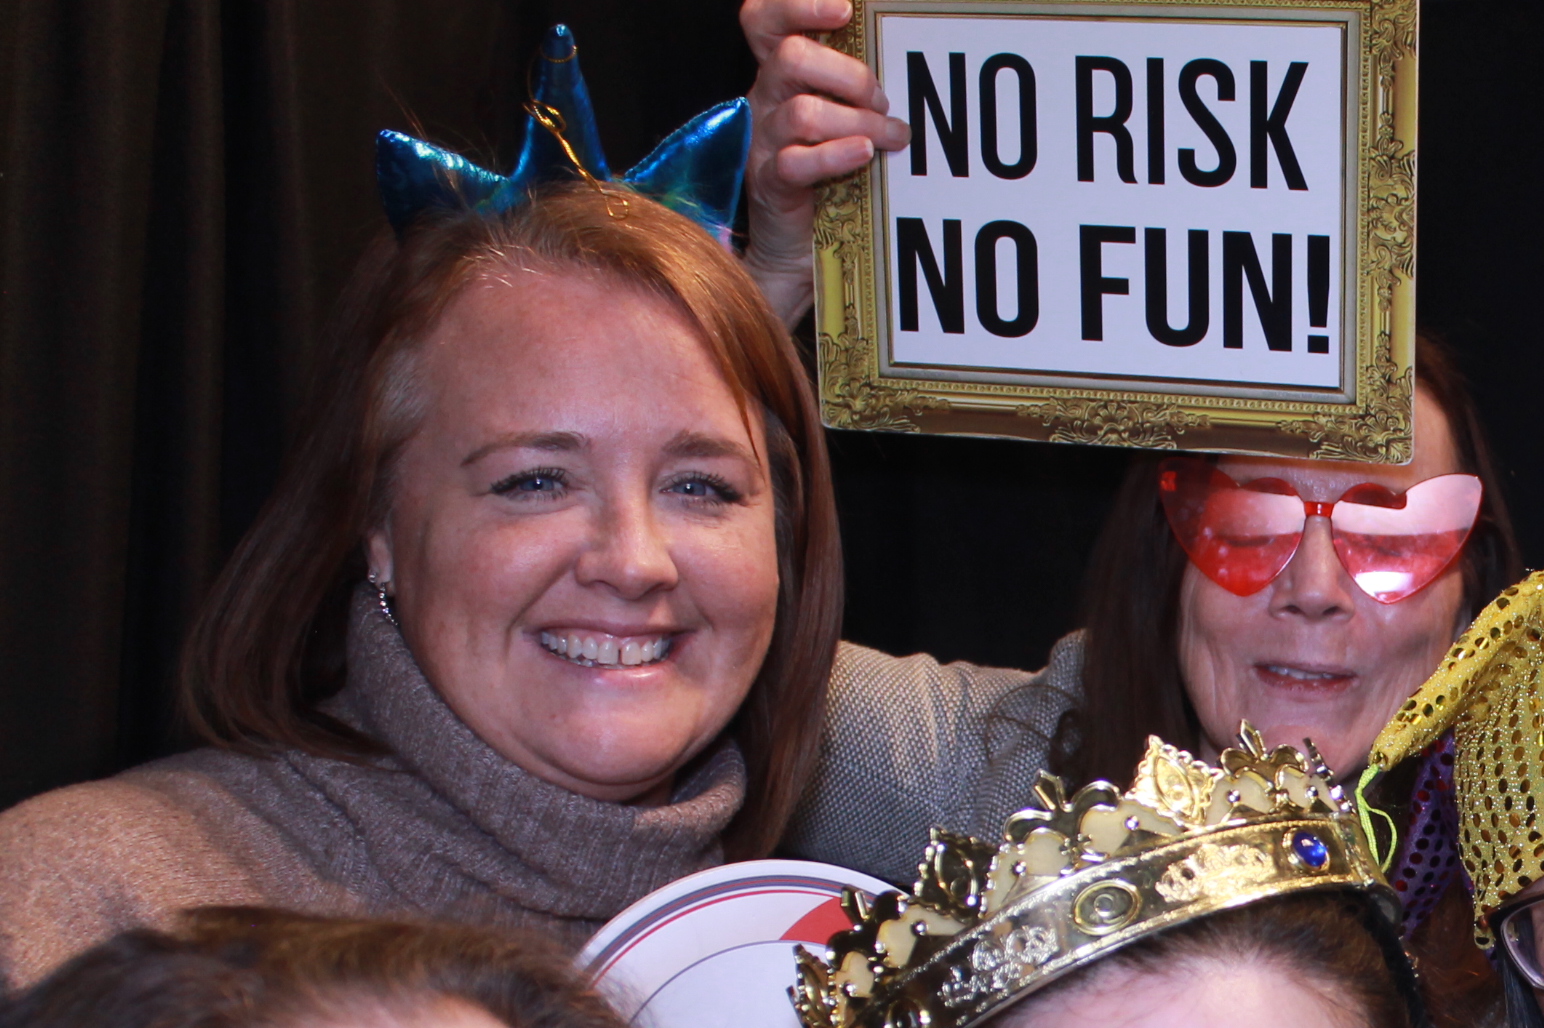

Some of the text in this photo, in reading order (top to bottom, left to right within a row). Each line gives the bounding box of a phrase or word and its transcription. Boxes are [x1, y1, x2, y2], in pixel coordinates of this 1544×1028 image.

[906, 51, 1310, 192] NO RISK
[896, 217, 1331, 355] NO FUN!
